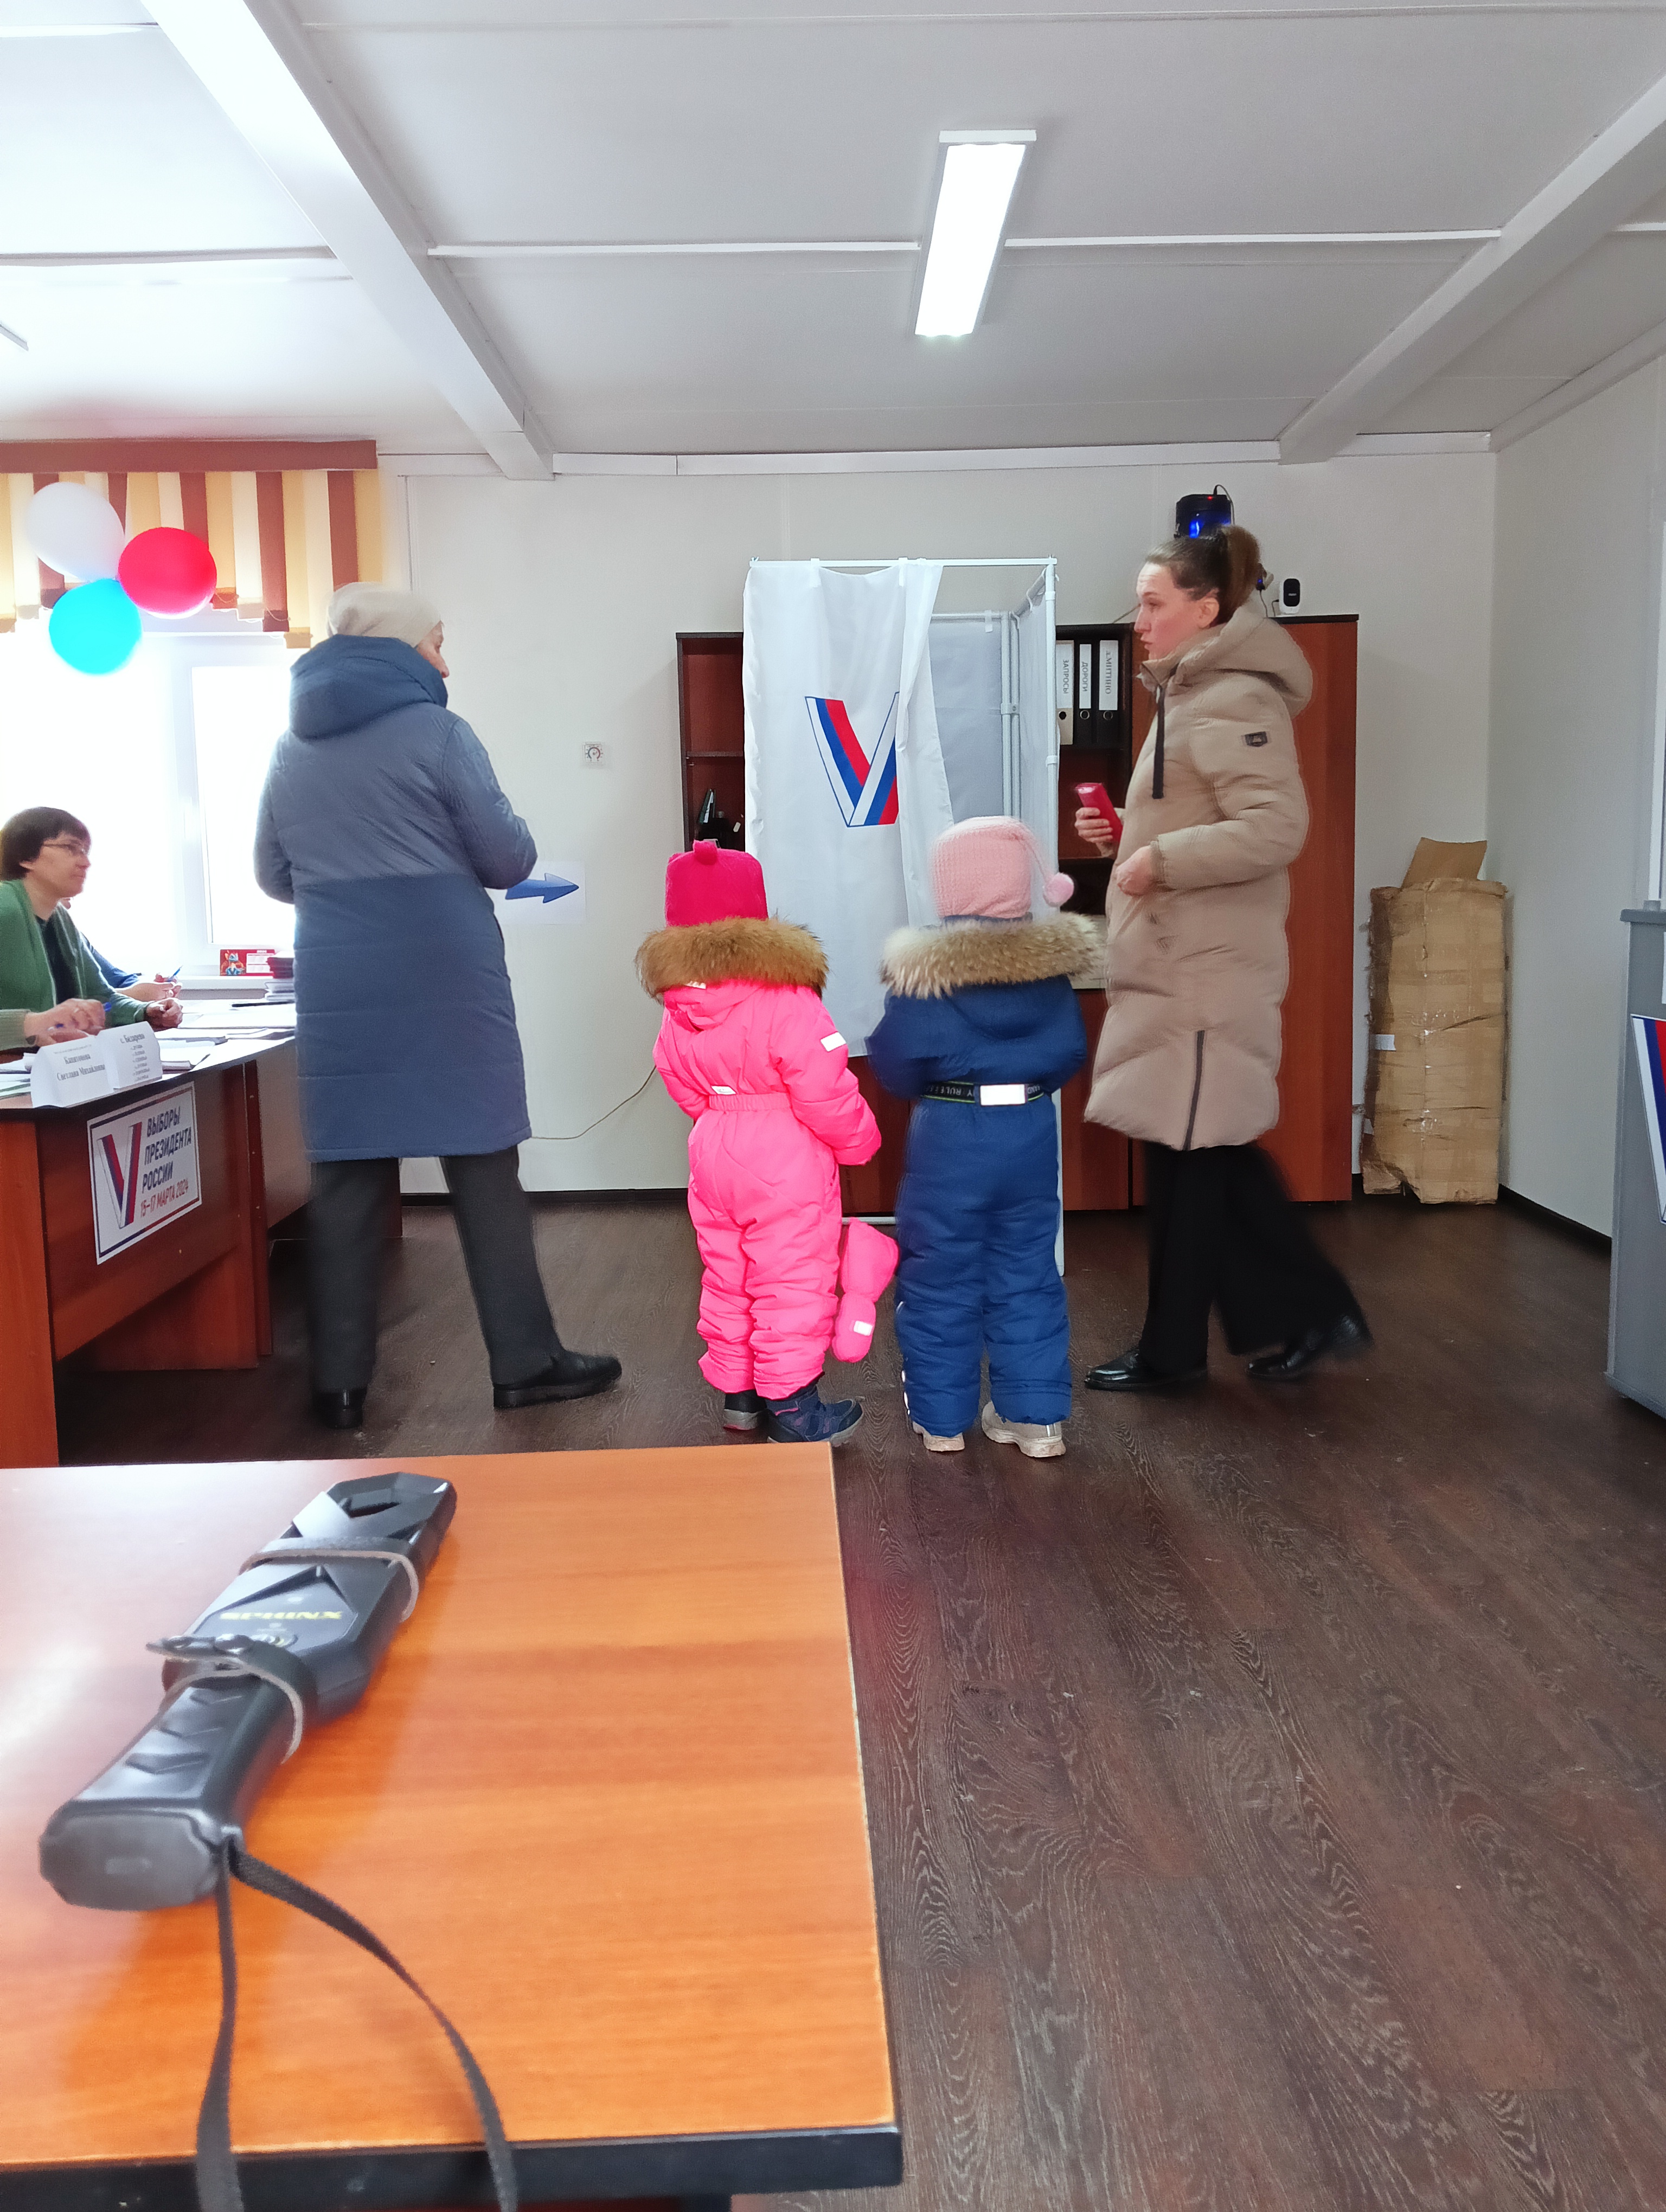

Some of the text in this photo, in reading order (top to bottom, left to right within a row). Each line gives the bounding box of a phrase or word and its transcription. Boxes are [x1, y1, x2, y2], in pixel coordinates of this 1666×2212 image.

[146, 1106, 181, 1137] ВЫБОРЫ
[144, 1127, 191, 1165] ПРЕЗИДЕНТА
[142, 1161, 174, 1193] РОССИИ
[157, 1185, 175, 1208] МАРТА
[176, 1178, 189, 1198] 2024
